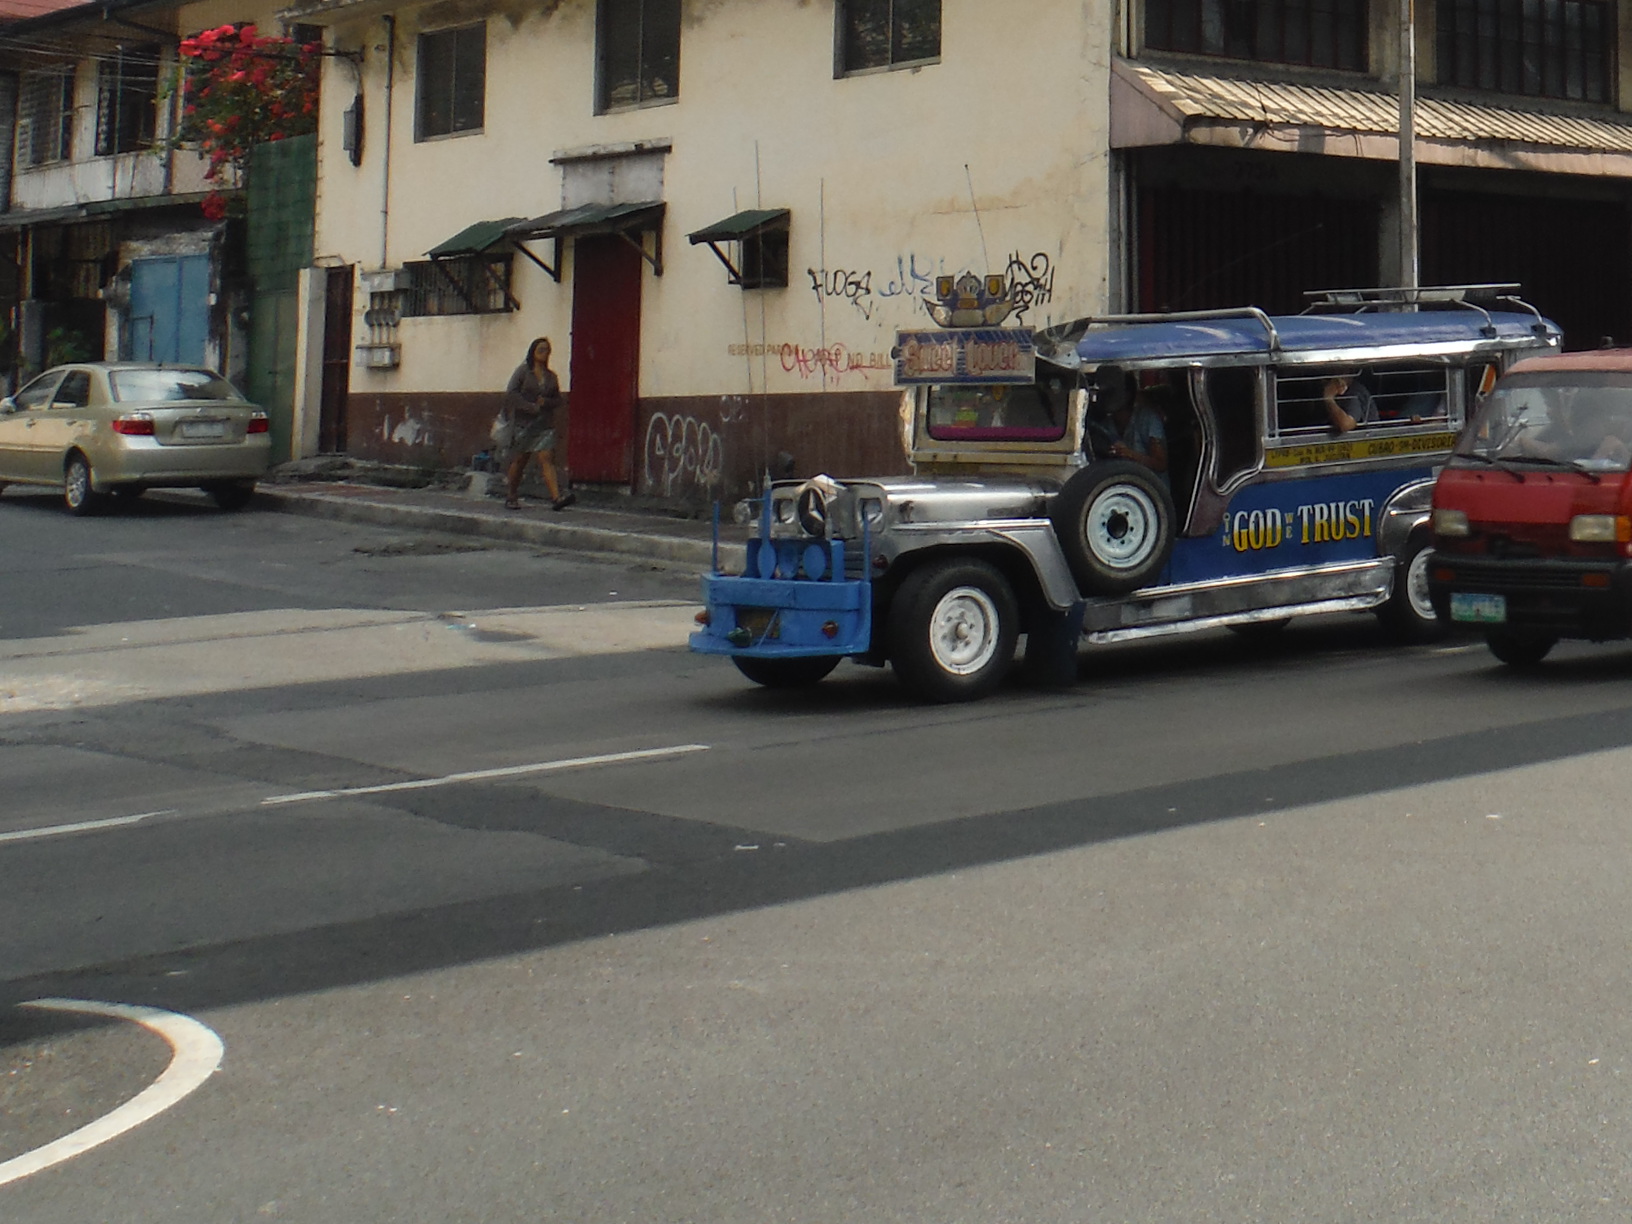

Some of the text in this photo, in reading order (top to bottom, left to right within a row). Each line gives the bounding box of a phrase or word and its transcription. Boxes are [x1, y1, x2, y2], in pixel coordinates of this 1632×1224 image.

[1233, 508, 1282, 552] GOD
[1284, 512, 1294, 539] WE
[1297, 498, 1374, 544] TRUST
